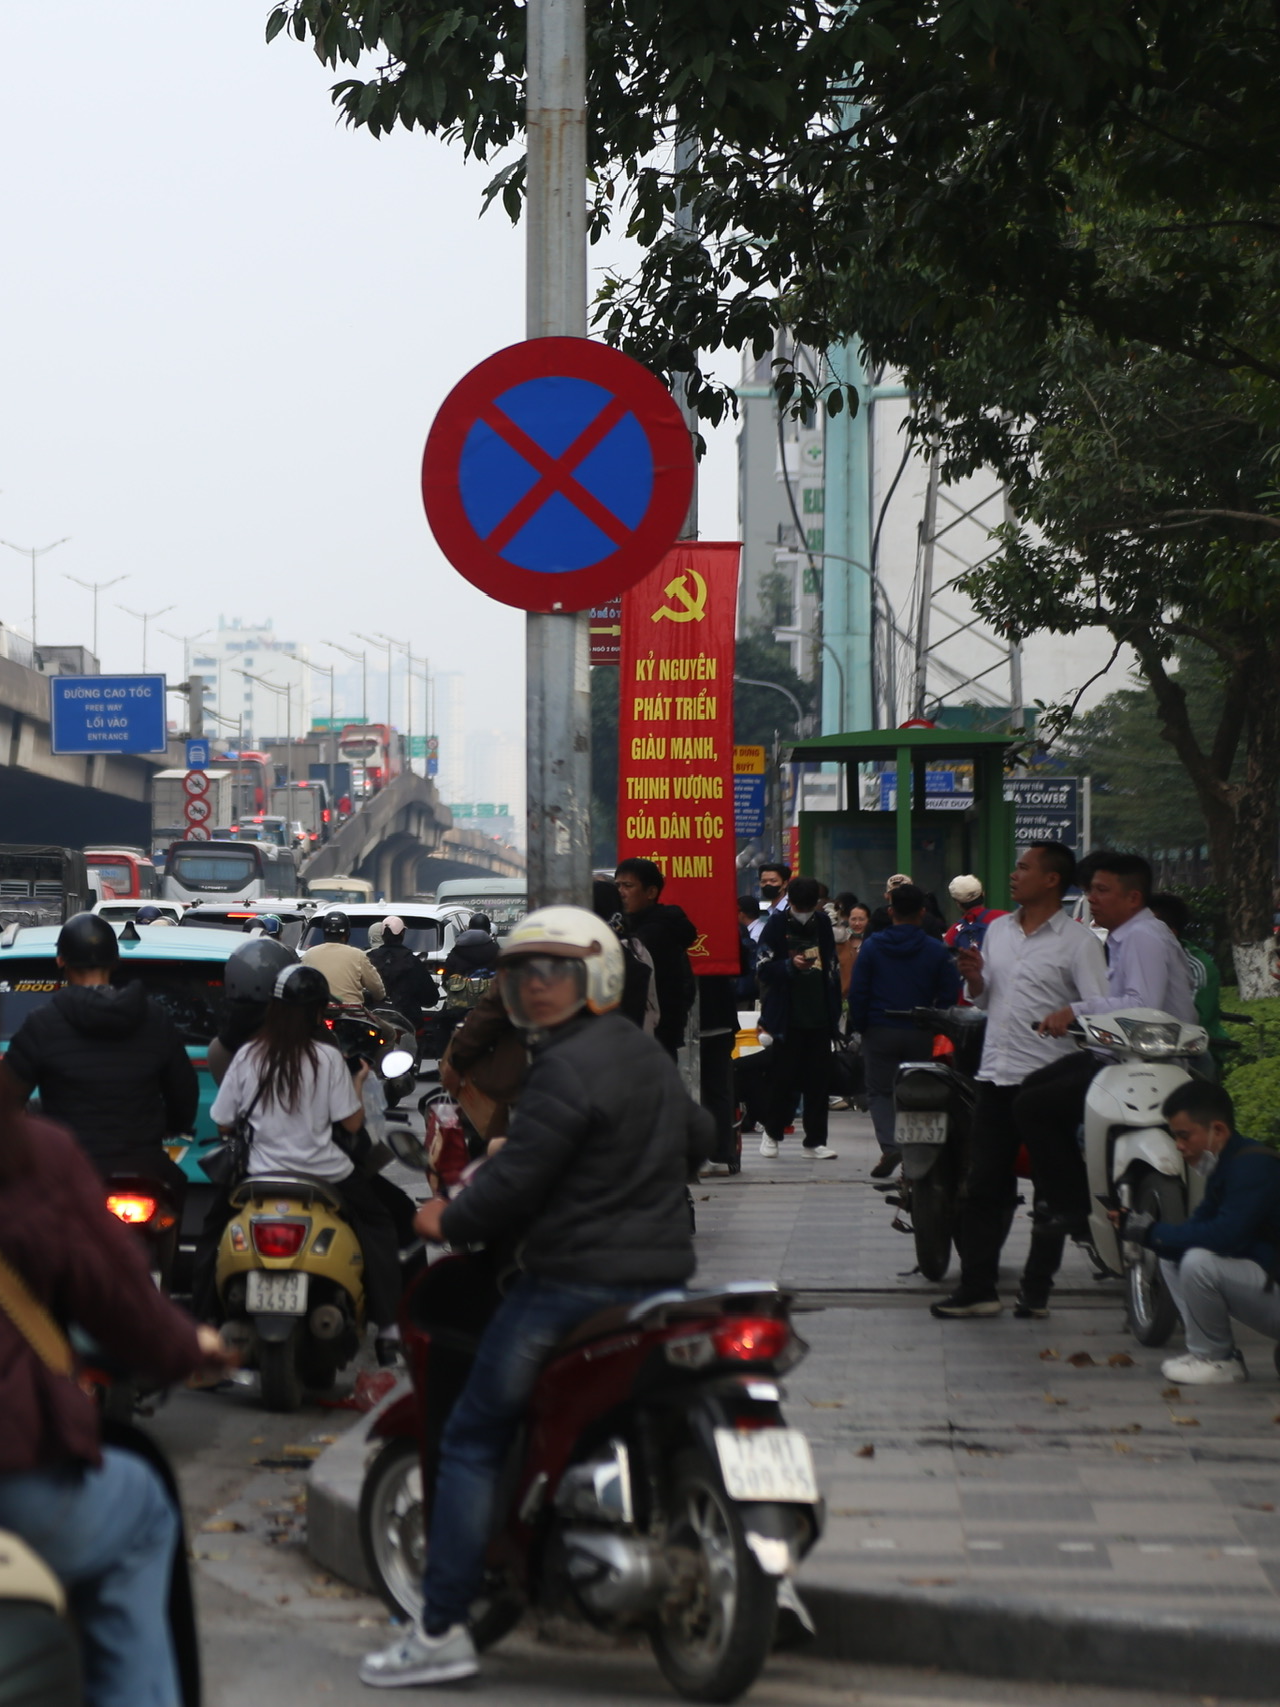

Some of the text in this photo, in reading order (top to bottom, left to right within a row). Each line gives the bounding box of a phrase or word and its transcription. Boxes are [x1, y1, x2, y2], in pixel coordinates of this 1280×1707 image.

[636, 651, 717, 680] KỶ NGUYÊN
[64, 685, 152, 699] ĐƯỜNG CAO TỐC
[85, 704, 104, 712] FREE
[634, 688, 717, 721] PHÁT TRIỂN
[86, 716, 128, 728] LỐI VÀO
[631, 733, 718, 764] GIÀU MẠNH,
[626, 774, 723, 804] THỊNH VƯỢNG
[1025, 792, 1067, 803] TOWER
[626, 812, 724, 843] CỦA DÂN TỘC
[1056, 827, 1062, 839] 1
[672, 856, 713, 878] NAM!
[255, 1292, 299, 1311] 3453
